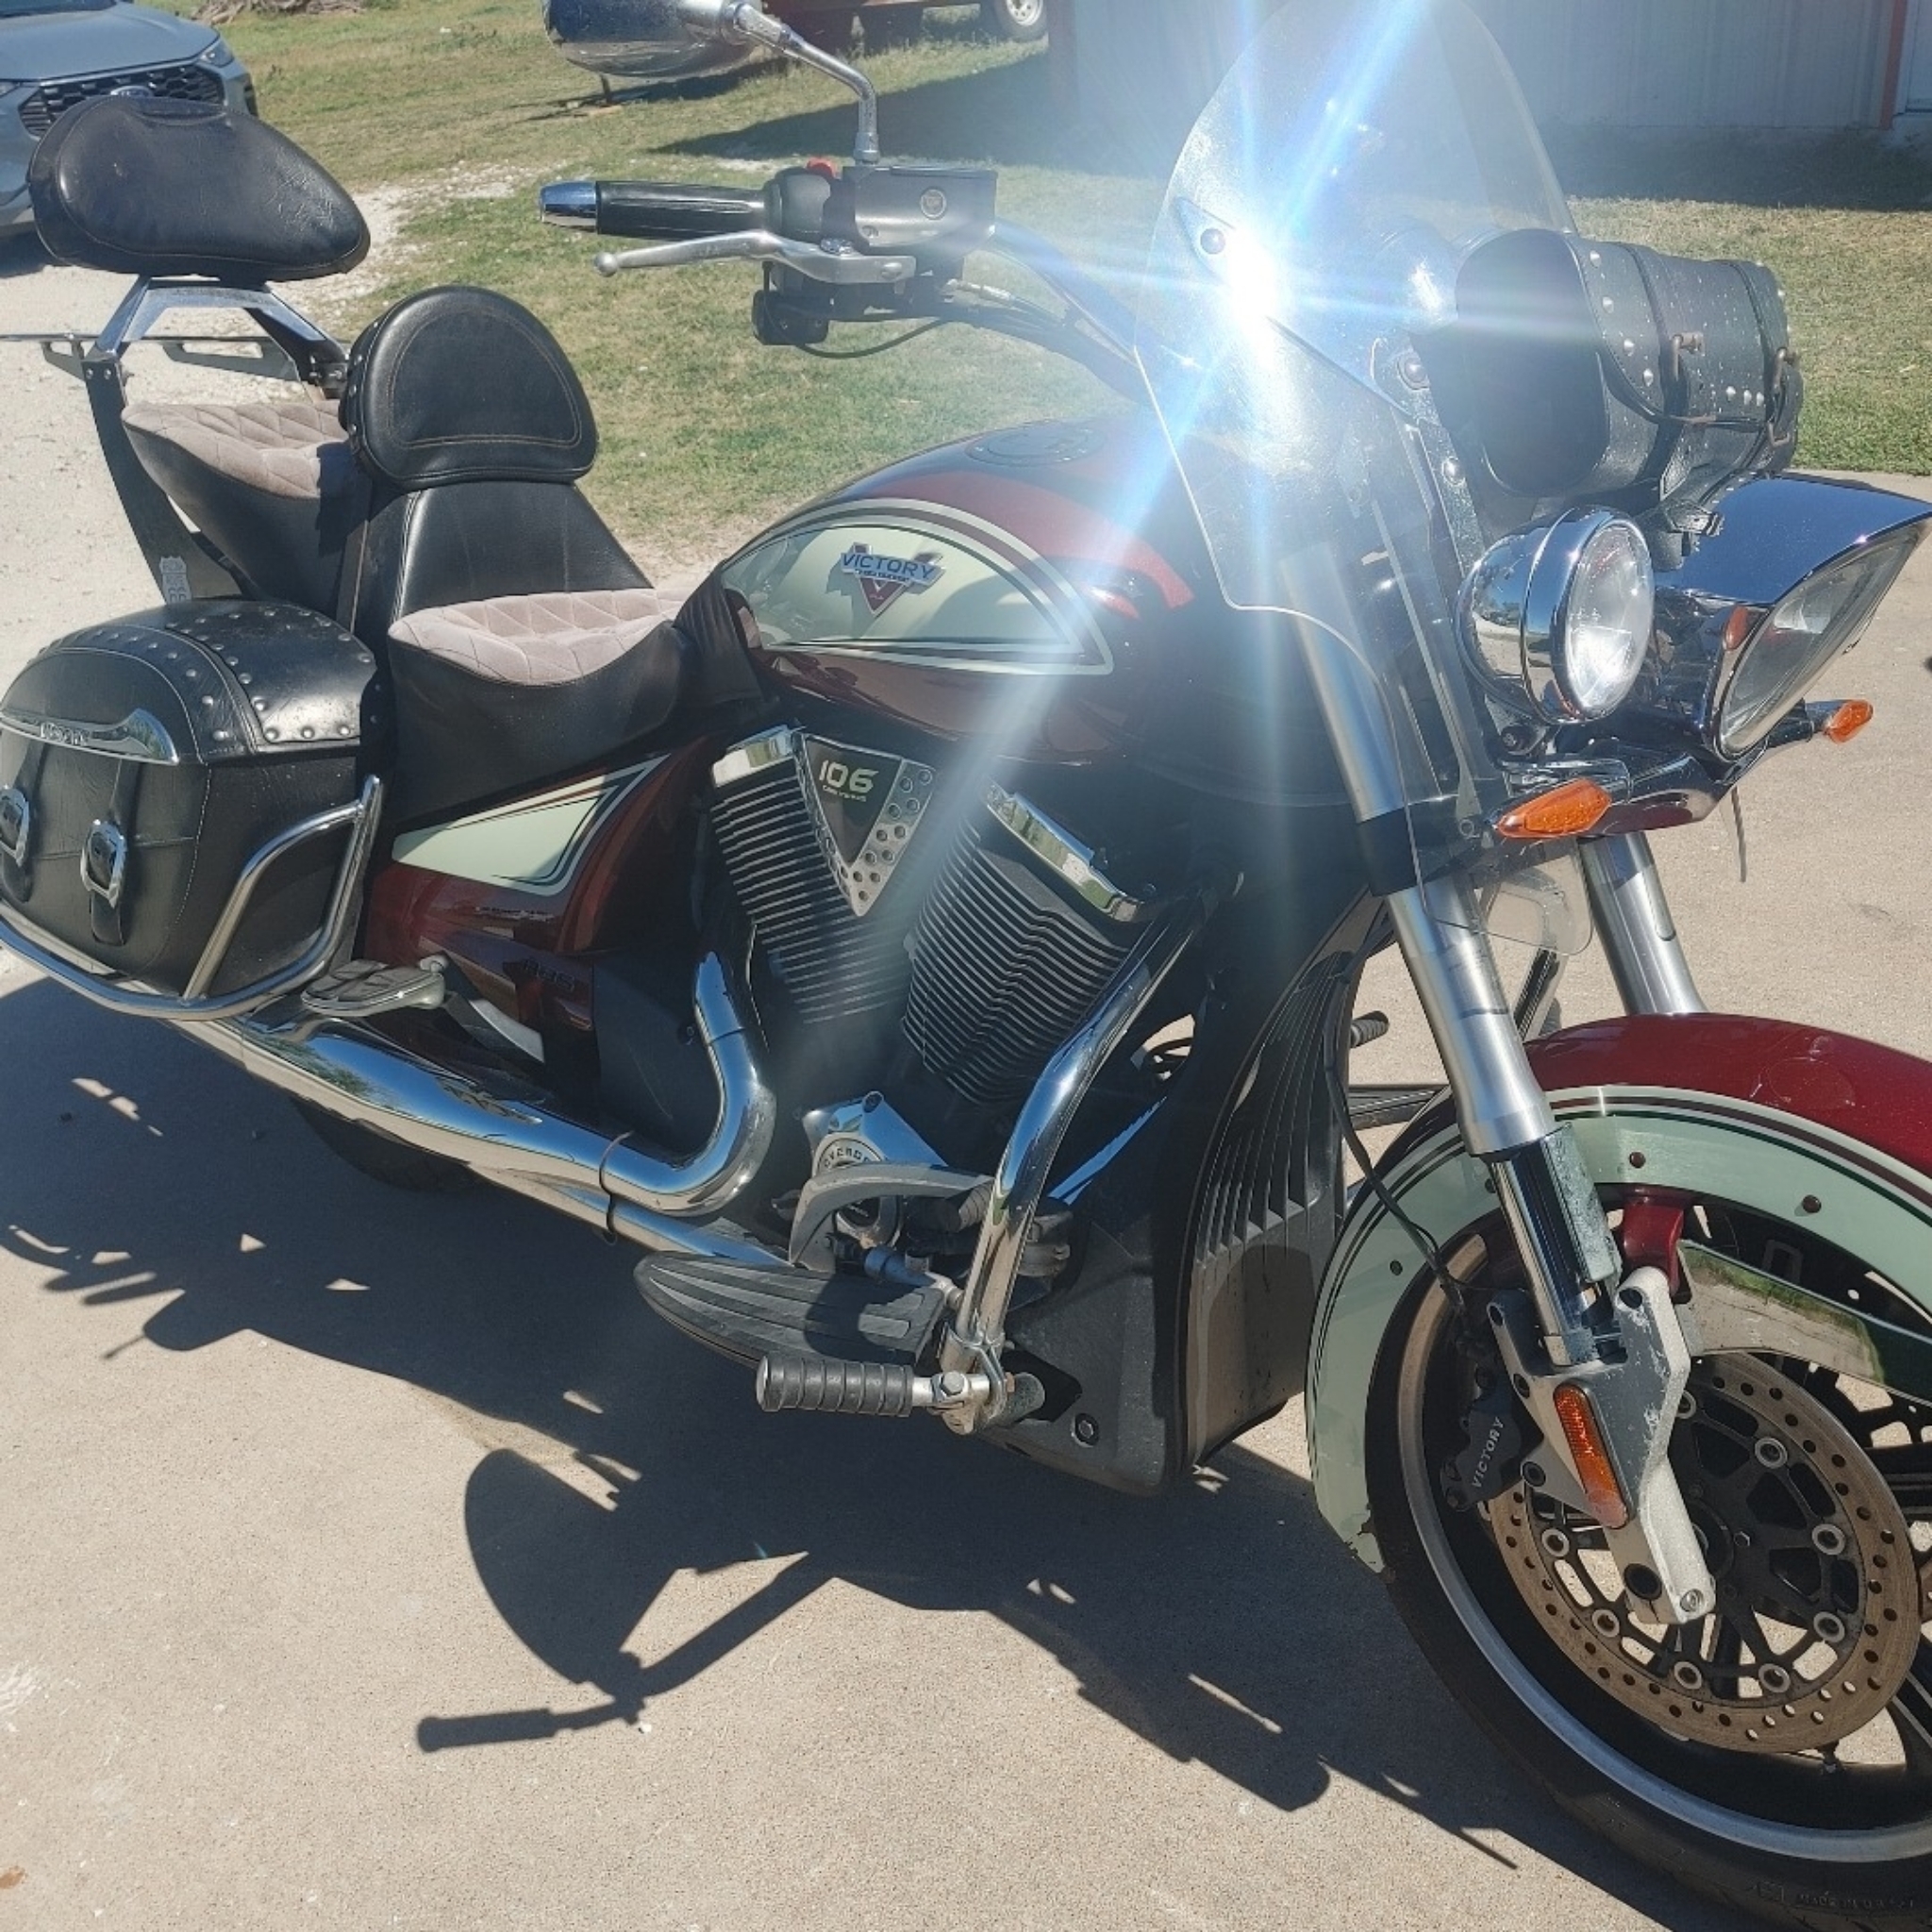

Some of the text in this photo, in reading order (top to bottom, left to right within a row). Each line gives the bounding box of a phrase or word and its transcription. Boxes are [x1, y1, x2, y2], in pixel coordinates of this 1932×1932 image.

[842, 553, 936, 579] VICTORY
[819, 759, 879, 793] 106
[528, 1416, 560, 1488] VICTORY
